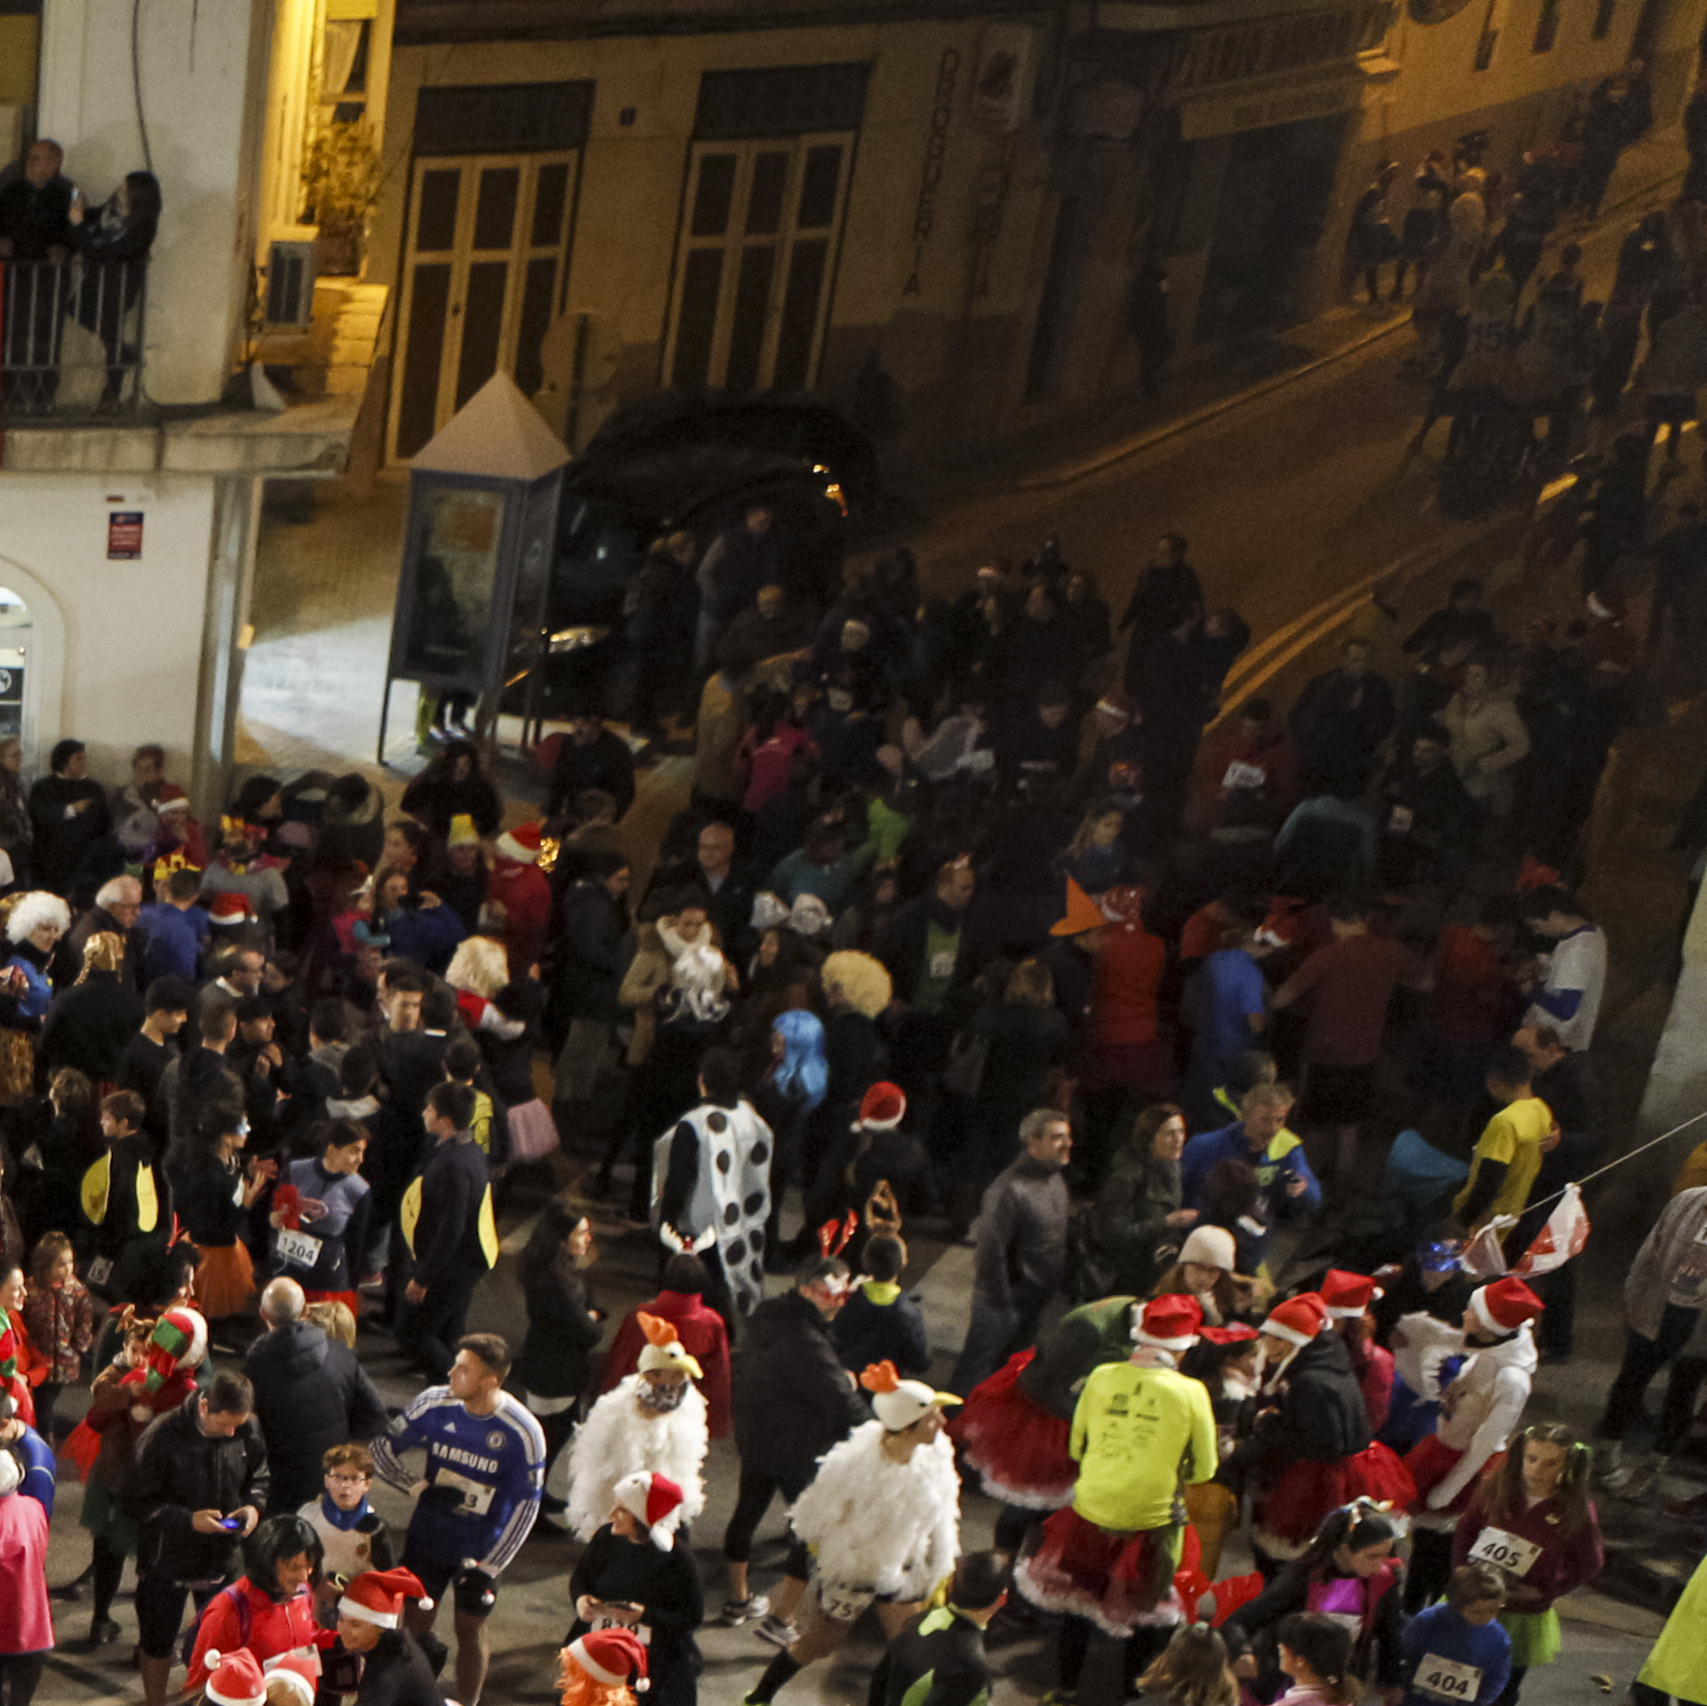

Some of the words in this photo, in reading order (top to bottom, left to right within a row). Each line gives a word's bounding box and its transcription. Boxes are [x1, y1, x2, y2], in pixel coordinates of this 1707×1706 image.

[281, 1236, 313, 1261] 1204
[433, 1443, 498, 1475] SAMSUNG
[1483, 1543, 1522, 1568] 405
[1427, 1671, 1468, 1695] 404
